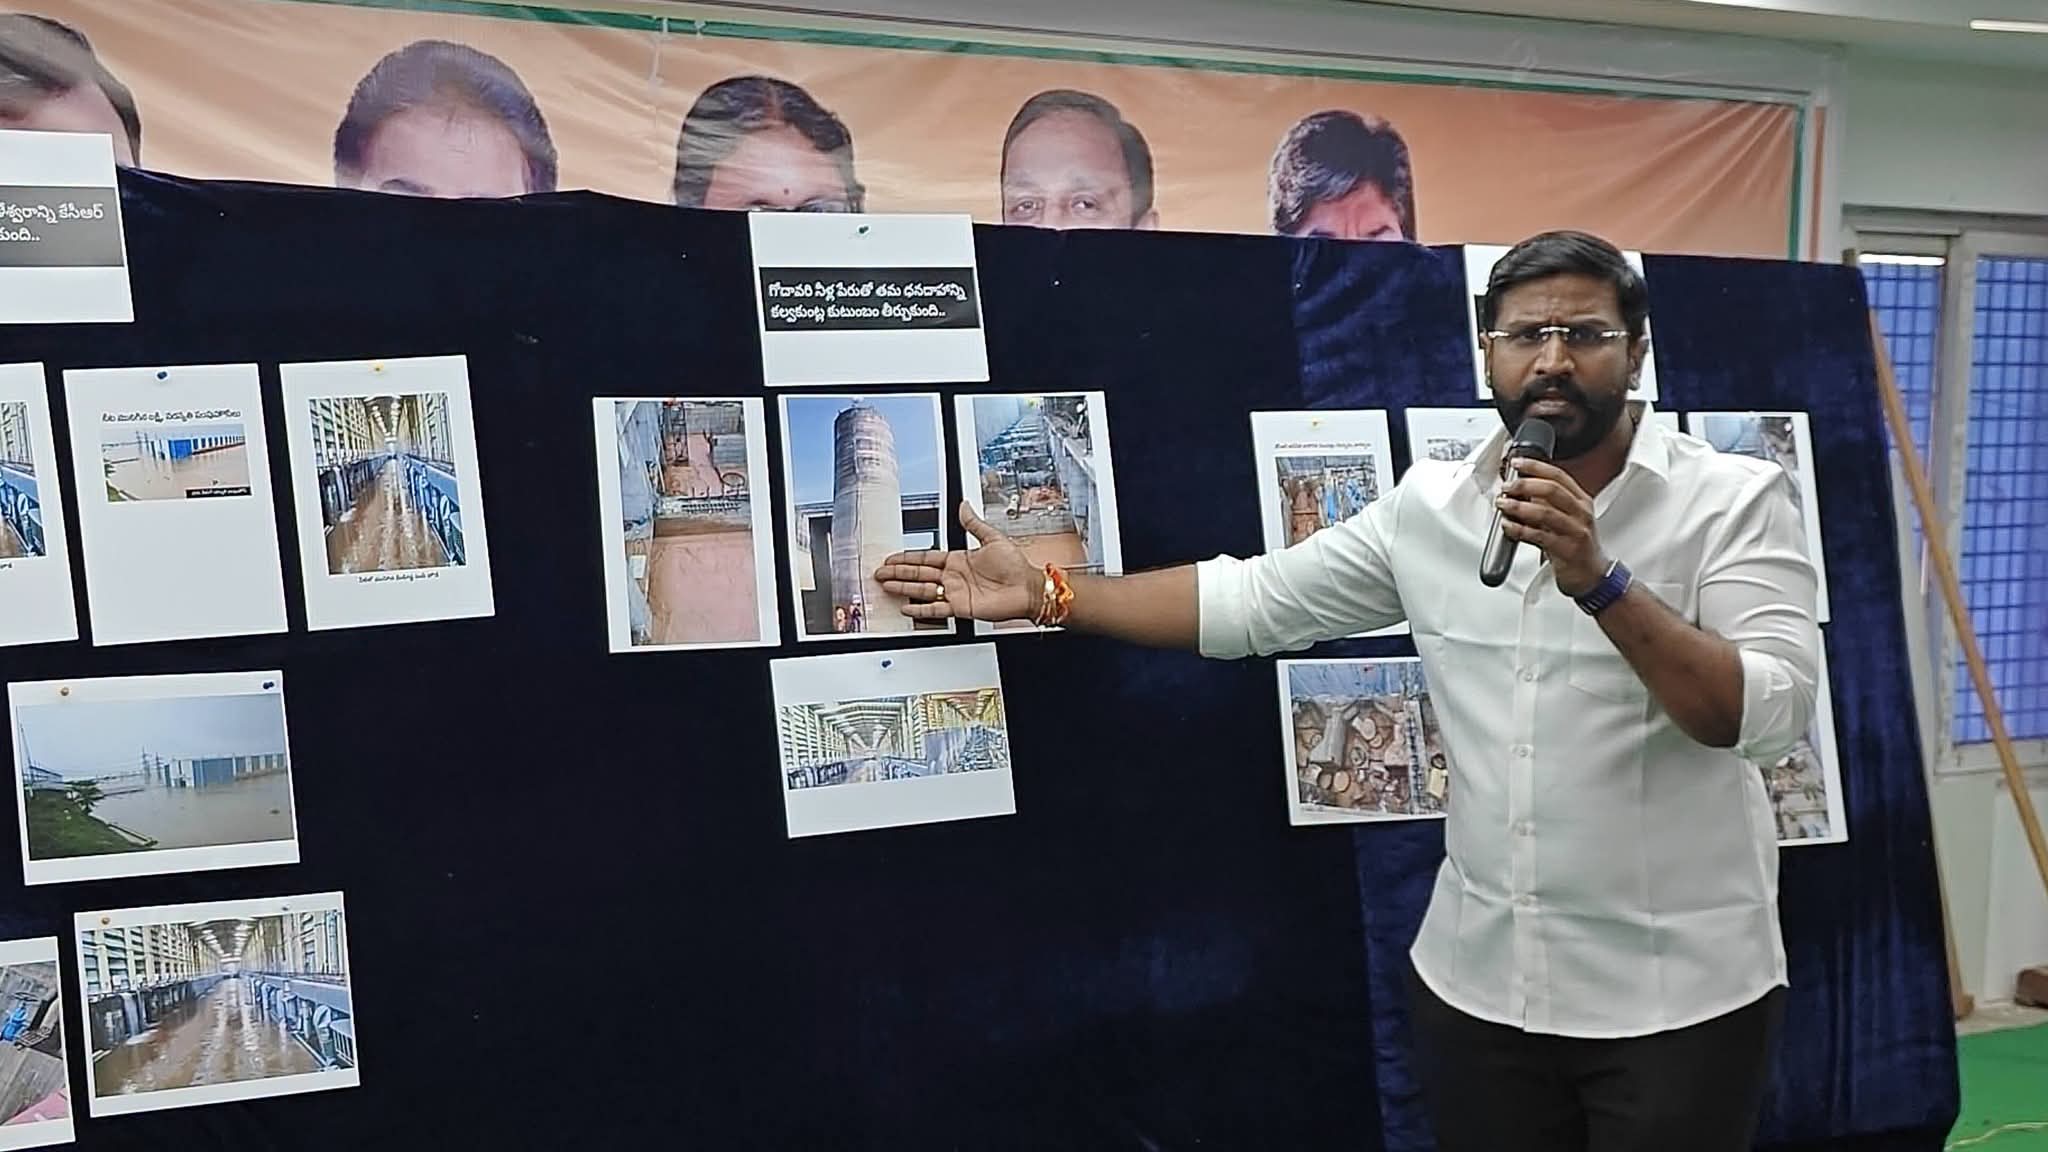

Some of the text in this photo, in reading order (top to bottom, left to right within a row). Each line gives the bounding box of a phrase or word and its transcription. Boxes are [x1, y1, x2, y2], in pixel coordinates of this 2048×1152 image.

[58, 202, 104, 219] కేసీఆర్
[768, 281, 967, 302] గోదావరి నీళ్ల పేరుతో తమ ధనదాహాన్ని
[771, 302, 947, 323] కల్వకుంట్ల కుటుంబం తీర్చుకుంది..
